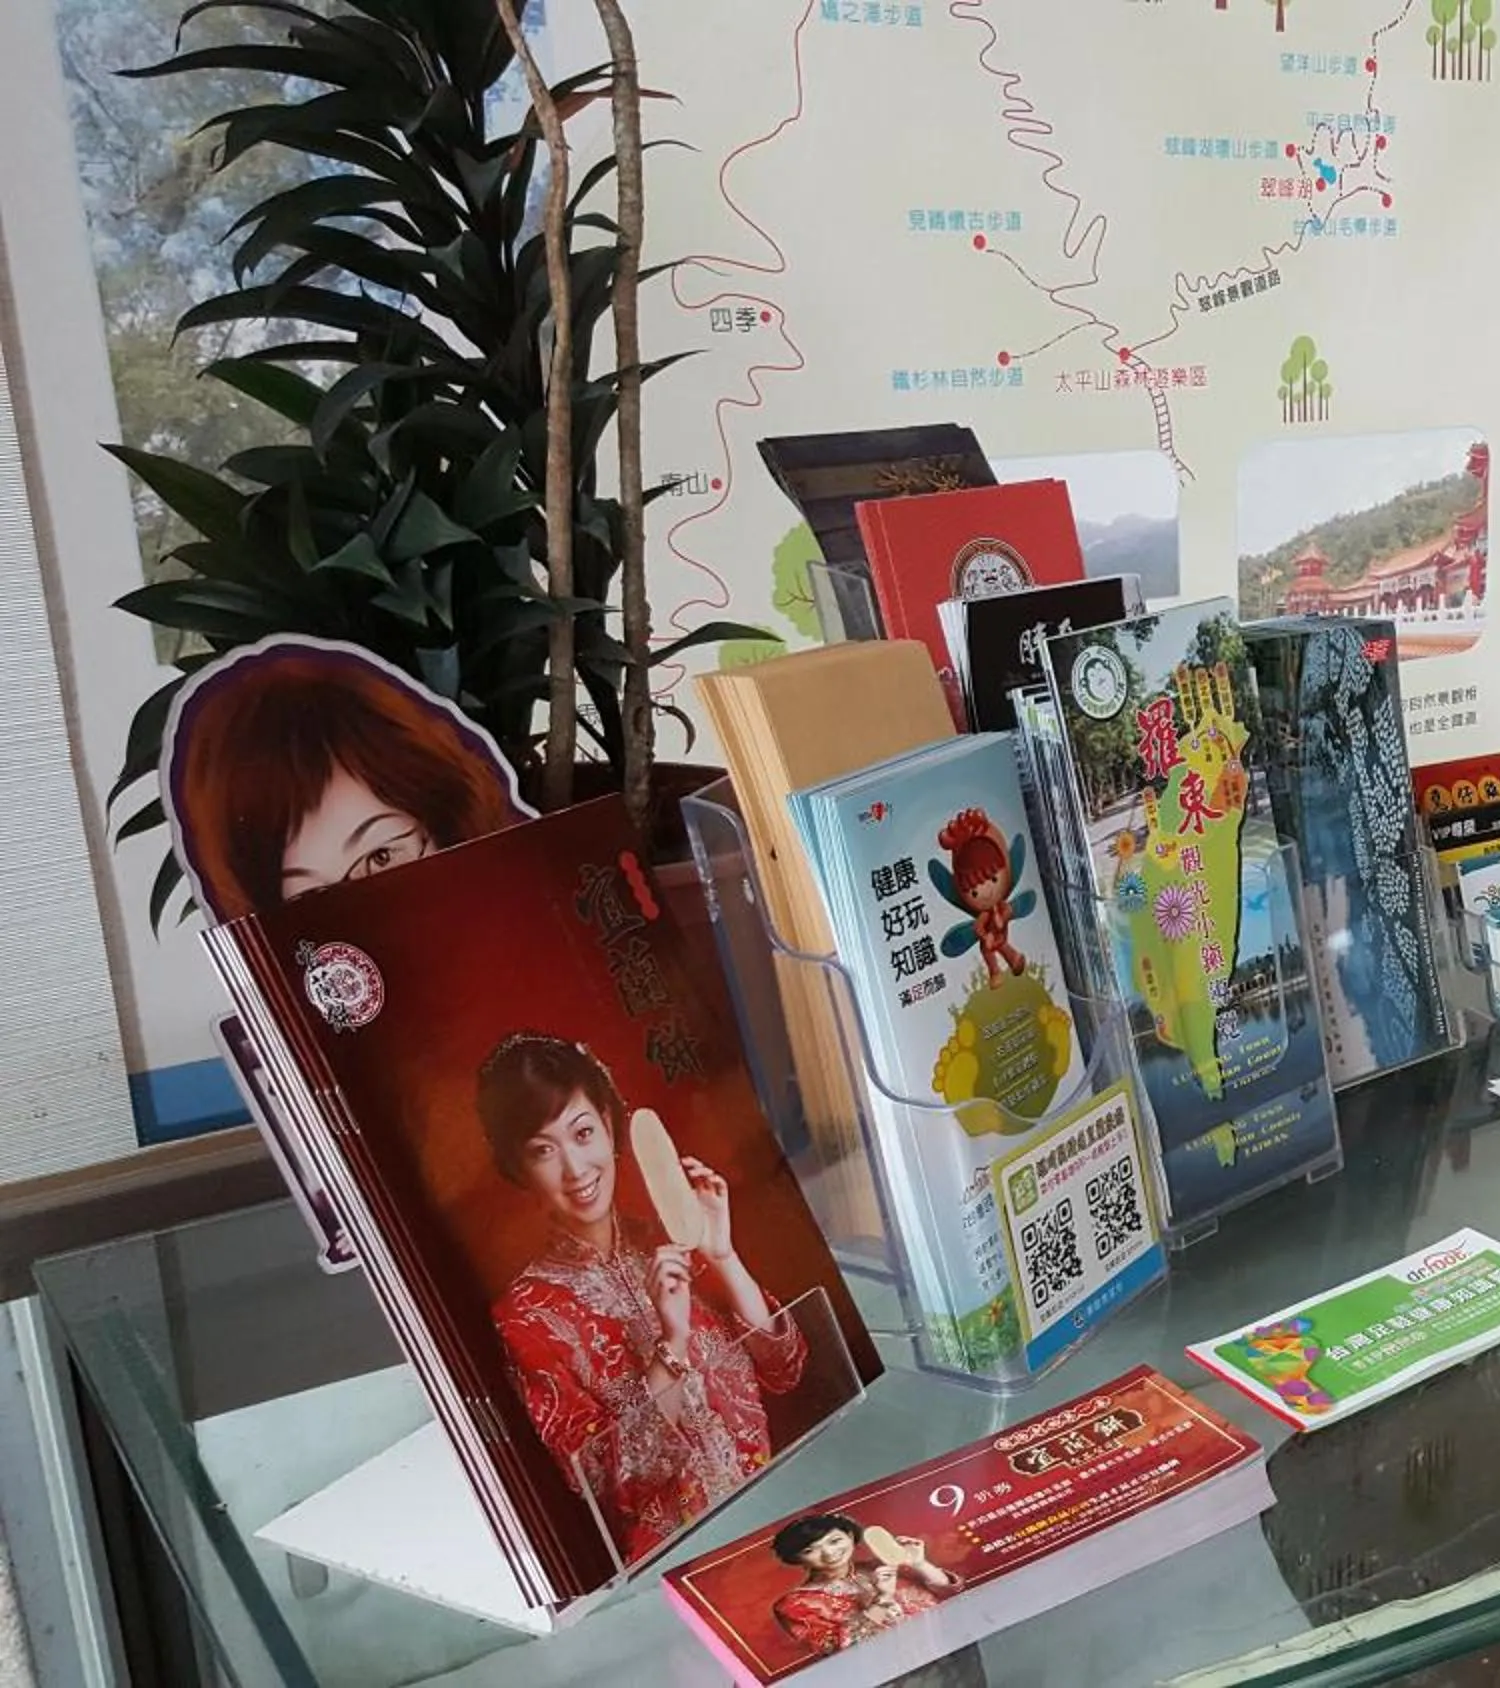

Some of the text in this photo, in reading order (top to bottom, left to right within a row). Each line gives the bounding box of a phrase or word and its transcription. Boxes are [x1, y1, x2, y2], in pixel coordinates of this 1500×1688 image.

[1260, 177, 1313, 200] 翠峰湖
[709, 307, 758, 334] 四季
[1136, 696, 1225, 836] 羅東
[870, 856, 919, 901] 健康
[881, 895, 930, 942] 好玩
[890, 936, 939, 982] 知識
